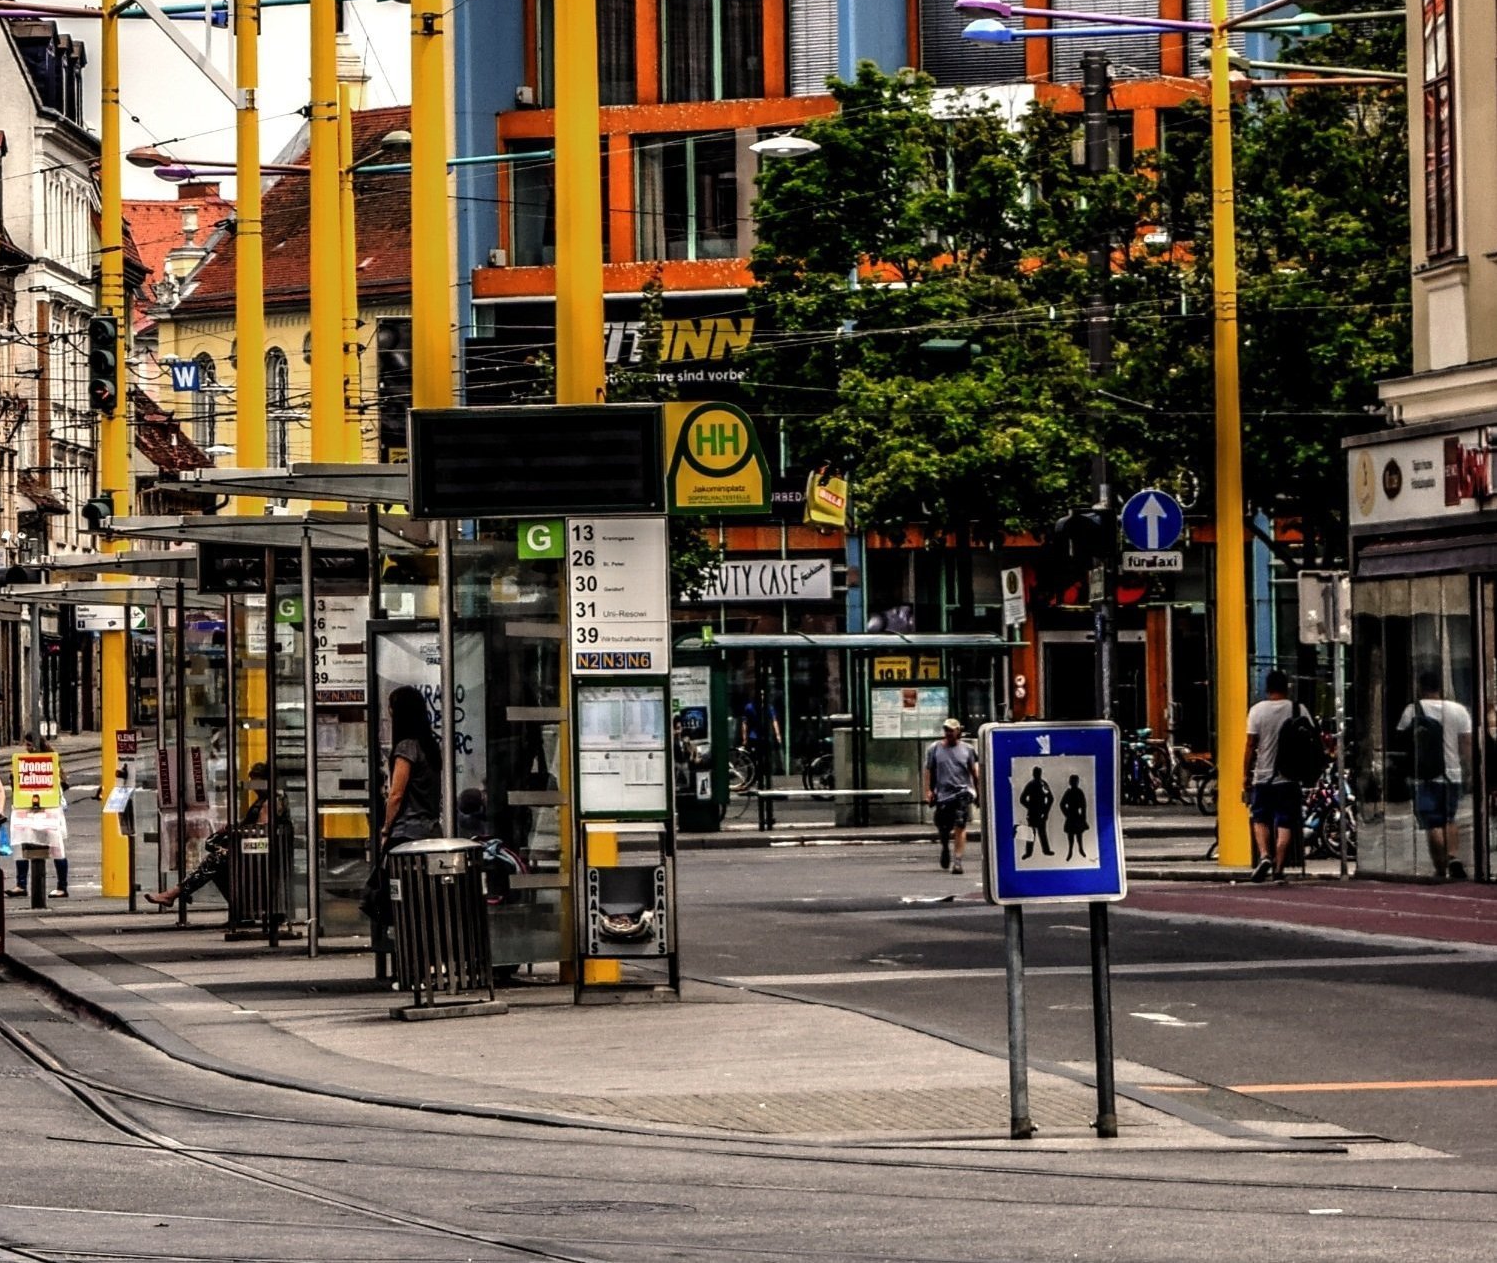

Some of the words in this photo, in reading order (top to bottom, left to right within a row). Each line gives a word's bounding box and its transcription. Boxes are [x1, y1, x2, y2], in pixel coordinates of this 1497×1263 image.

[173, 366, 196, 387] W
[677, 370, 705, 382] sind
[695, 423, 740, 457] HH
[692, 484, 746, 494] Jakominiplatz
[526, 524, 552, 552] G
[572, 525, 595, 541] 13
[572, 550, 596, 567] 26
[1127, 555, 1148, 567] für
[1149, 555, 1178, 568] Taxi
[575, 575, 598, 592] 30
[758, 564, 799, 595] CASE
[278, 598, 296, 617] G
[575, 601, 596, 618] 31
[576, 627, 599, 644] 39
[577, 654, 601, 668] N2
[602, 654, 625, 668] N3
[627, 653, 651, 667] N6
[18, 760, 53, 773] Kronen
[18, 772, 54, 786] Zeitung
[590, 870, 599, 954] GRATIS
[656, 870, 666, 954] GRATIS
